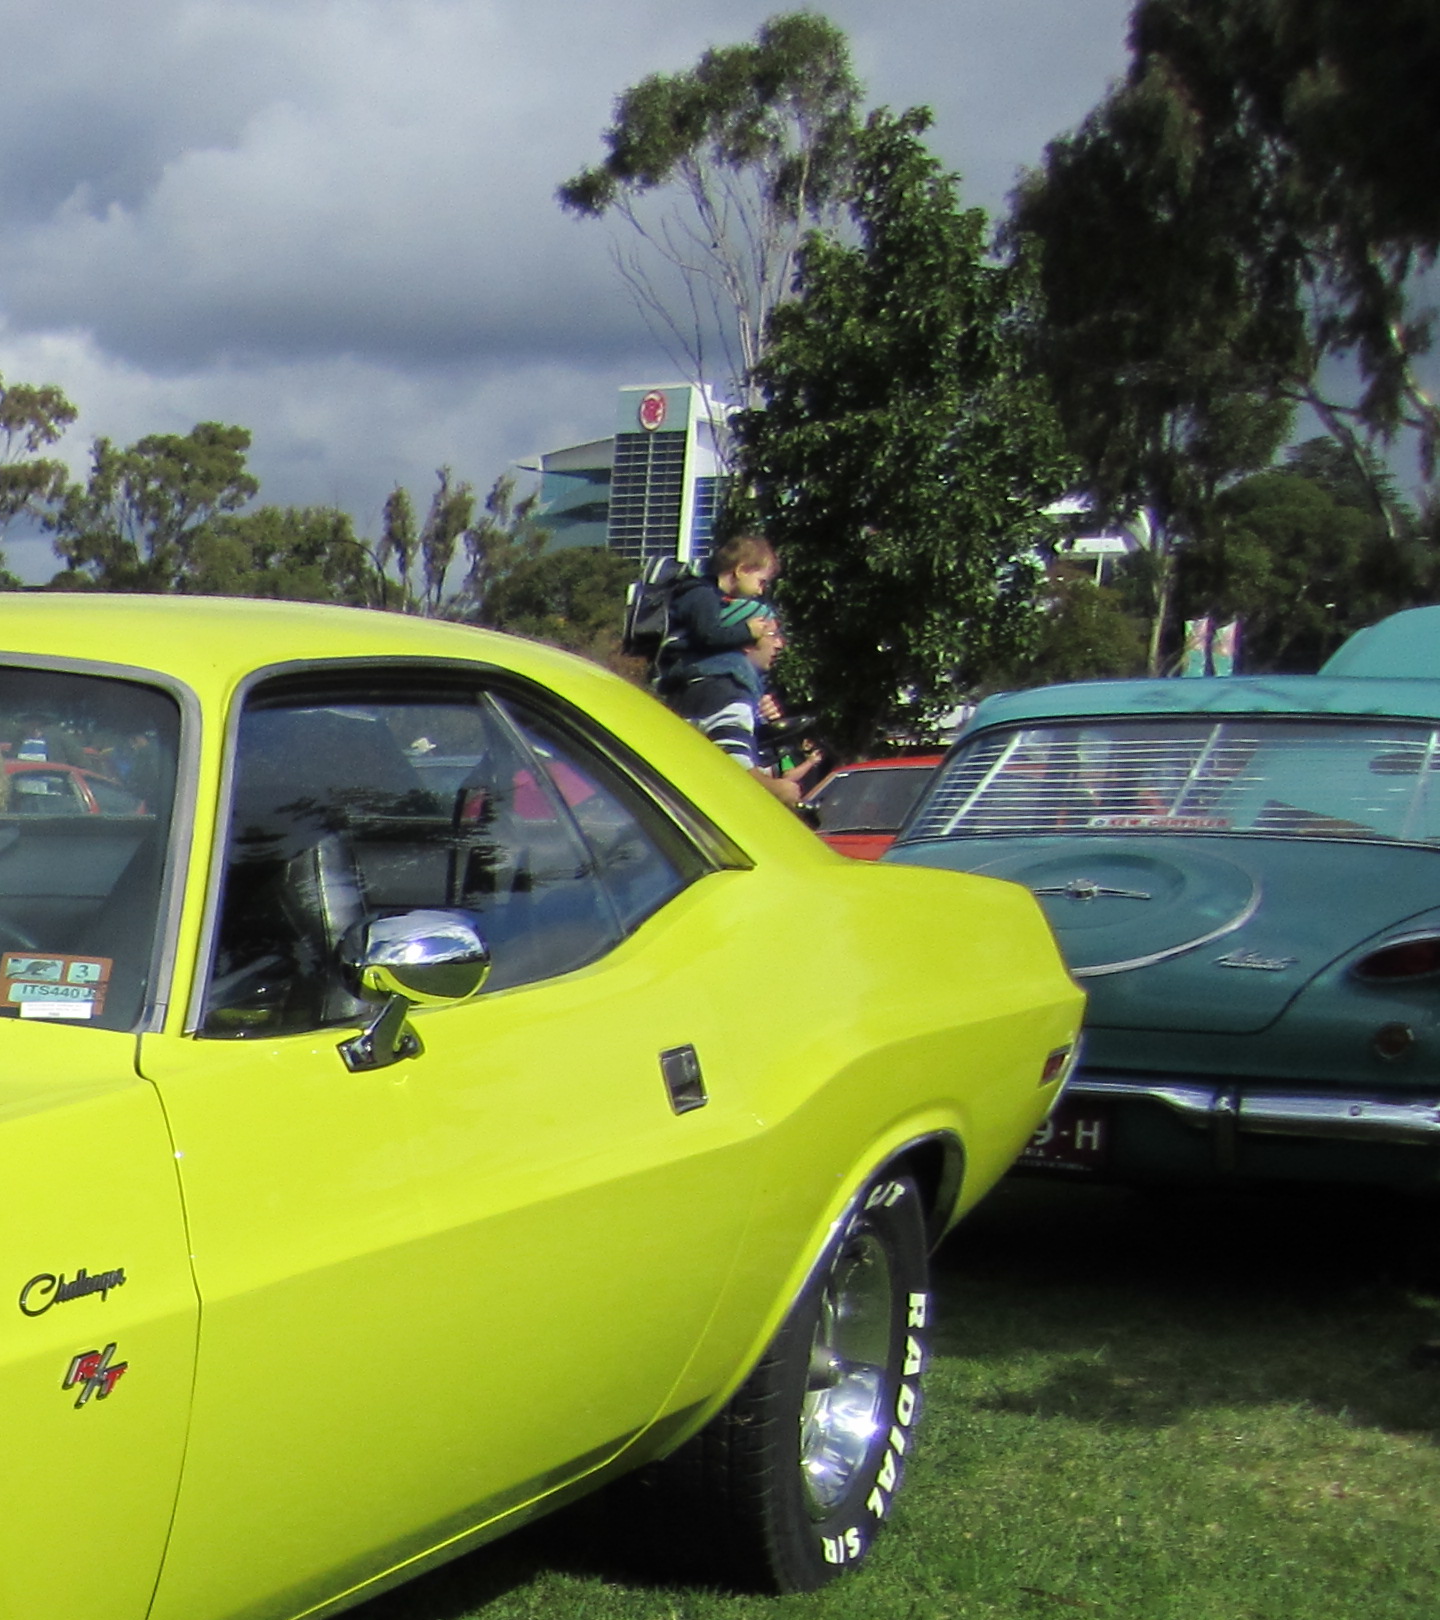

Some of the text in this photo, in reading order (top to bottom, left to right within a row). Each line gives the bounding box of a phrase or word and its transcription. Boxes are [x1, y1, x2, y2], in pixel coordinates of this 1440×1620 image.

[22, 984, 80, 999] ITS440
[61, 1341, 129, 1410] R/T
[866, 1292, 928, 1519] RADIAL
